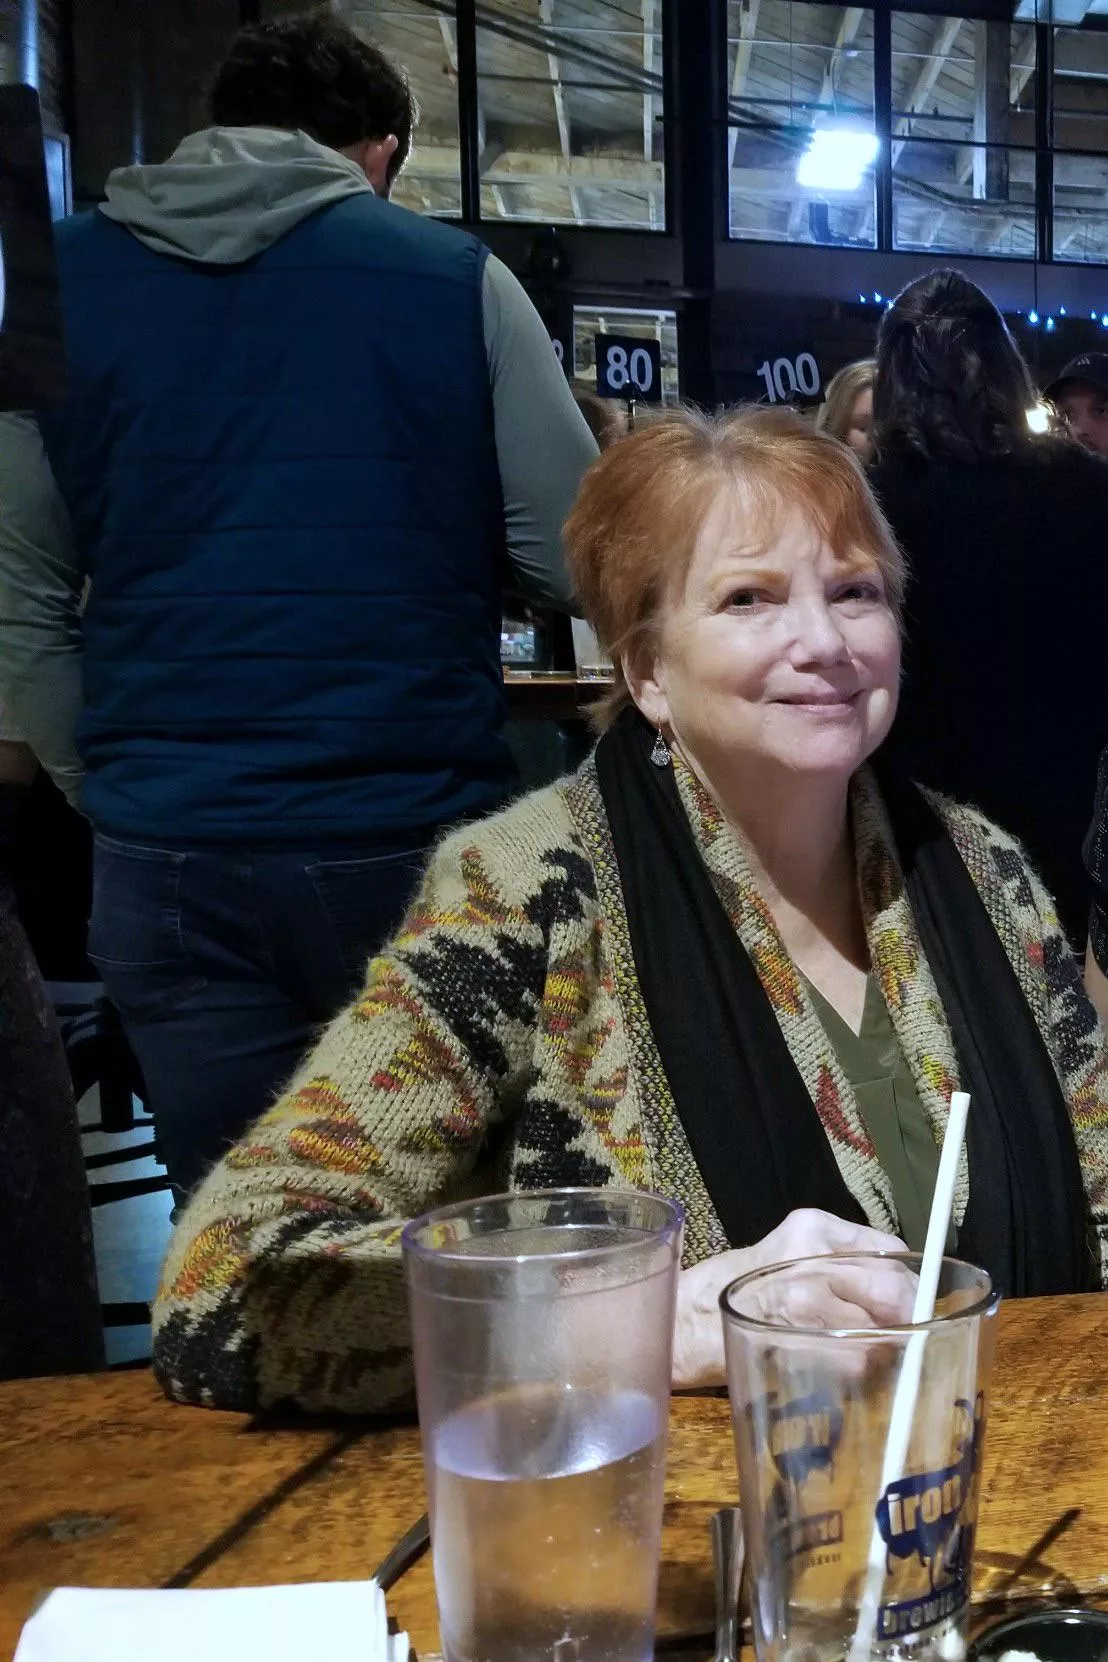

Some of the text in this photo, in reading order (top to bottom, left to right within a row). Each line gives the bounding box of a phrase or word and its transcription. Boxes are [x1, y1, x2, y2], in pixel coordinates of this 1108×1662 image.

[606, 345, 653, 392] 80
[756, 352, 820, 402] 100
[887, 1474, 961, 1536] iron
